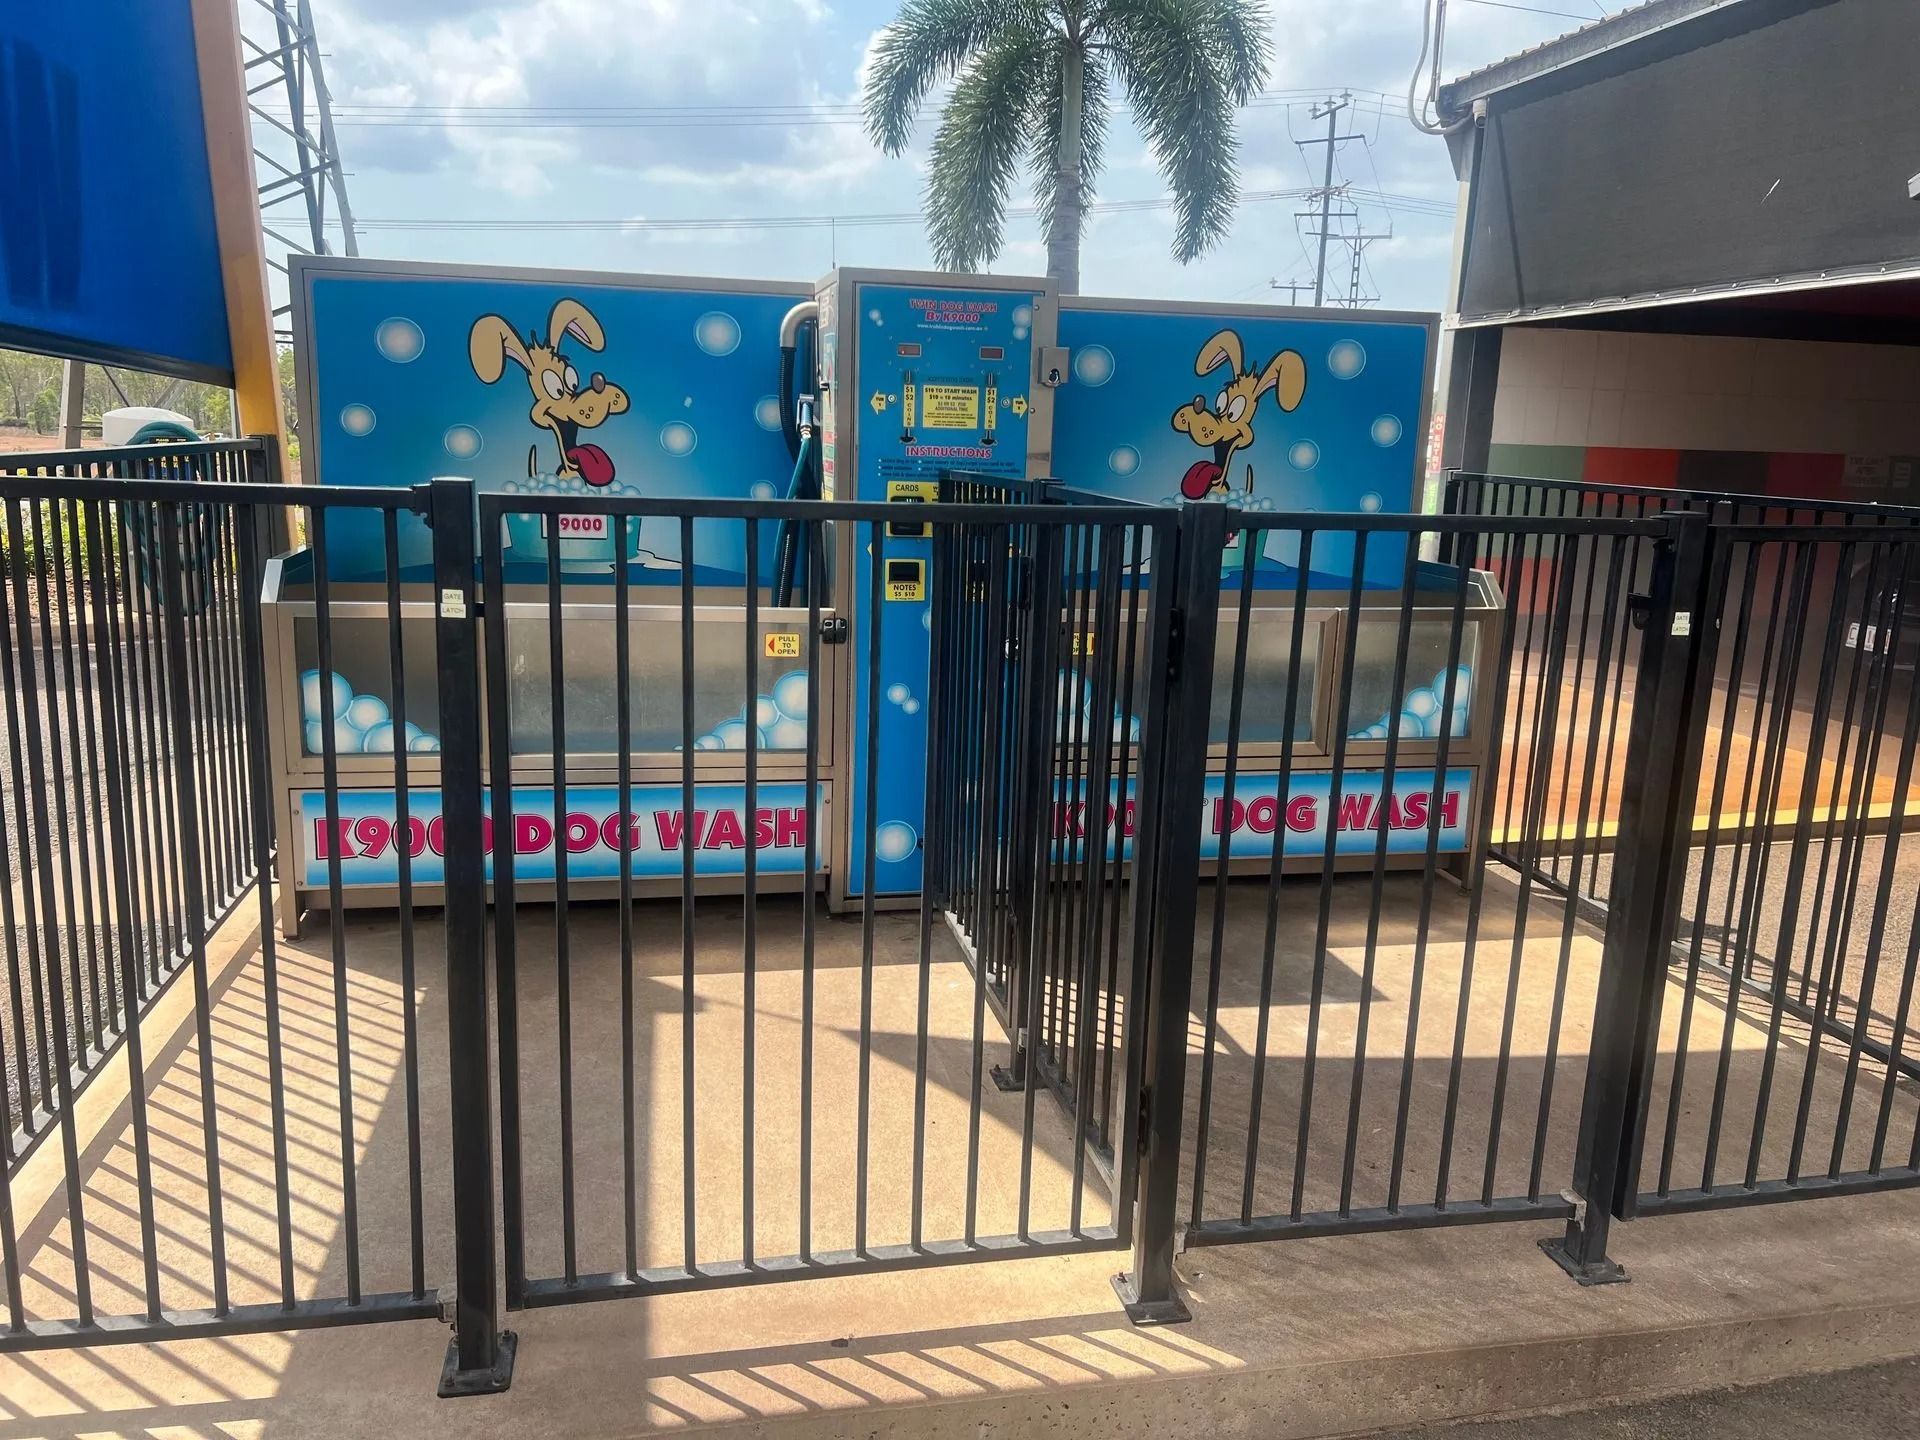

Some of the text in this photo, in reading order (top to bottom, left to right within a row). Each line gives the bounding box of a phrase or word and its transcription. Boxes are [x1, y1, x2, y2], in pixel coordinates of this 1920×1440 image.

[909, 299, 997, 313] TWIN DOG WASH
[925, 311, 980, 323] By K9000
[1435, 415, 1444, 430] NO
[905, 445, 993, 459] INSTRUCTIONS
[1431, 434, 1441, 470] ENTRY
[895, 484, 920, 492] CARDS
[559, 517, 603, 533] 9000
[1212, 791, 1461, 835] DOG WASH
[513, 811, 641, 854] DOG
[653, 807, 808, 851] WASH
